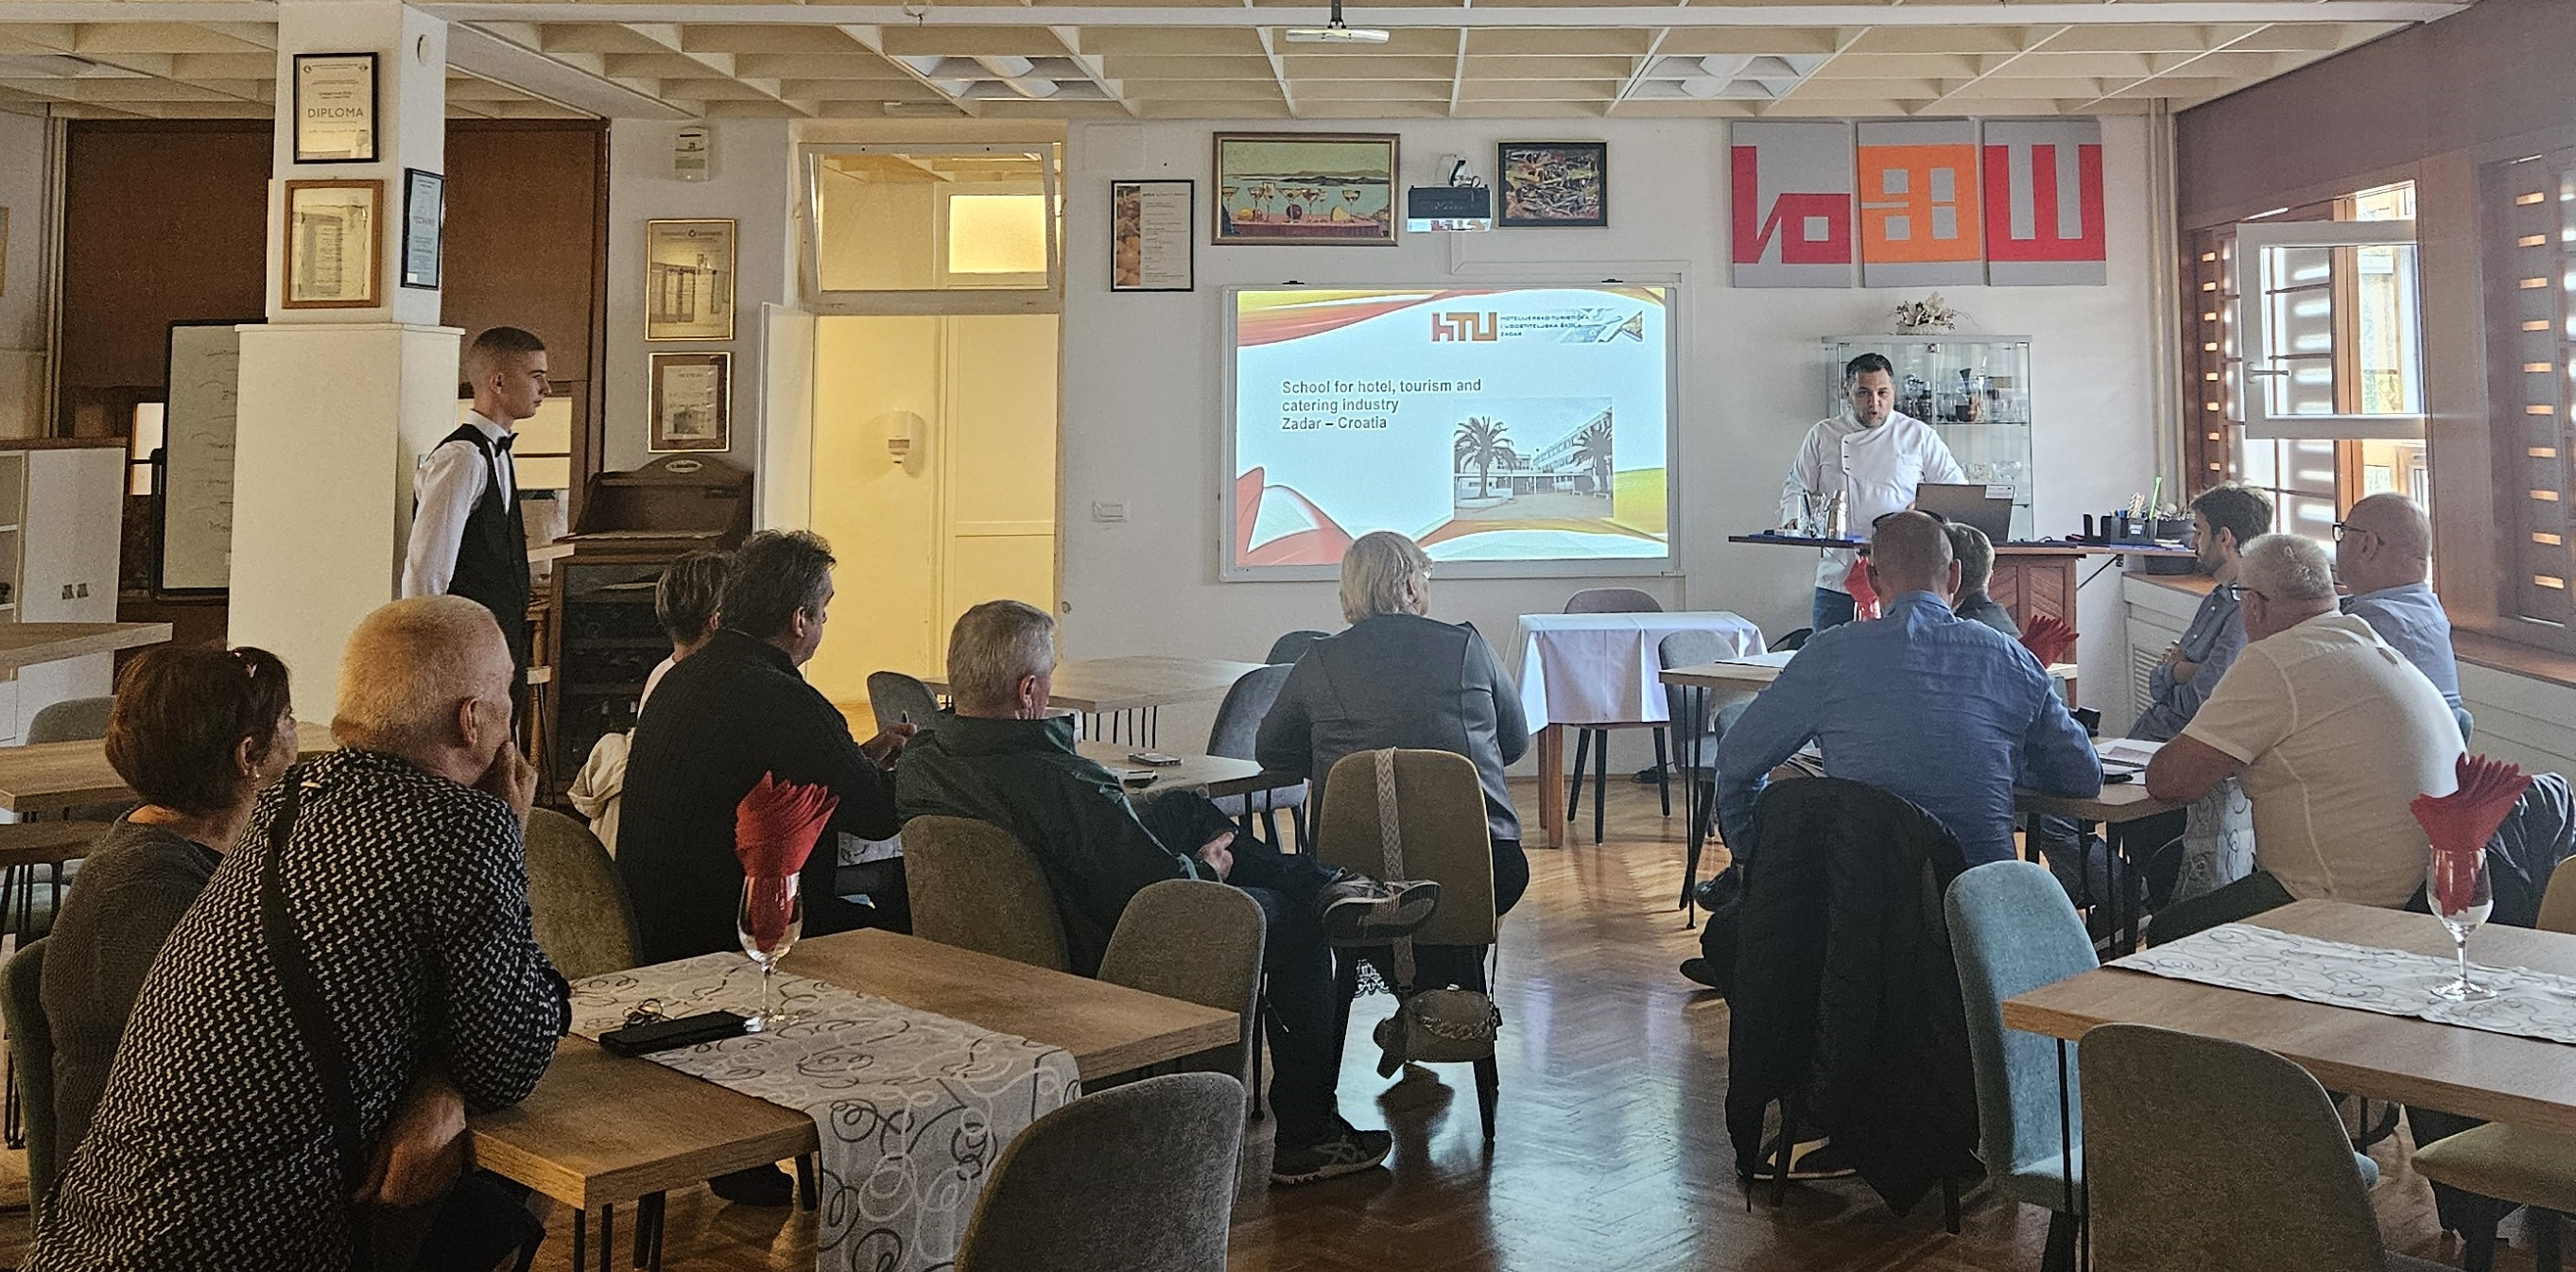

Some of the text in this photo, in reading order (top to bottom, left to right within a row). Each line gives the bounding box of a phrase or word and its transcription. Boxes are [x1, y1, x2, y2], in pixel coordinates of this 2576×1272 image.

[307, 108, 364, 118] DIPLOMA
[1282, 378, 1481, 395] School for hotel, tourism and
[1282, 398, 1399, 414] catering industry
[1282, 417, 1322, 430] Zadar
[1338, 416, 1387, 429] Croatia
